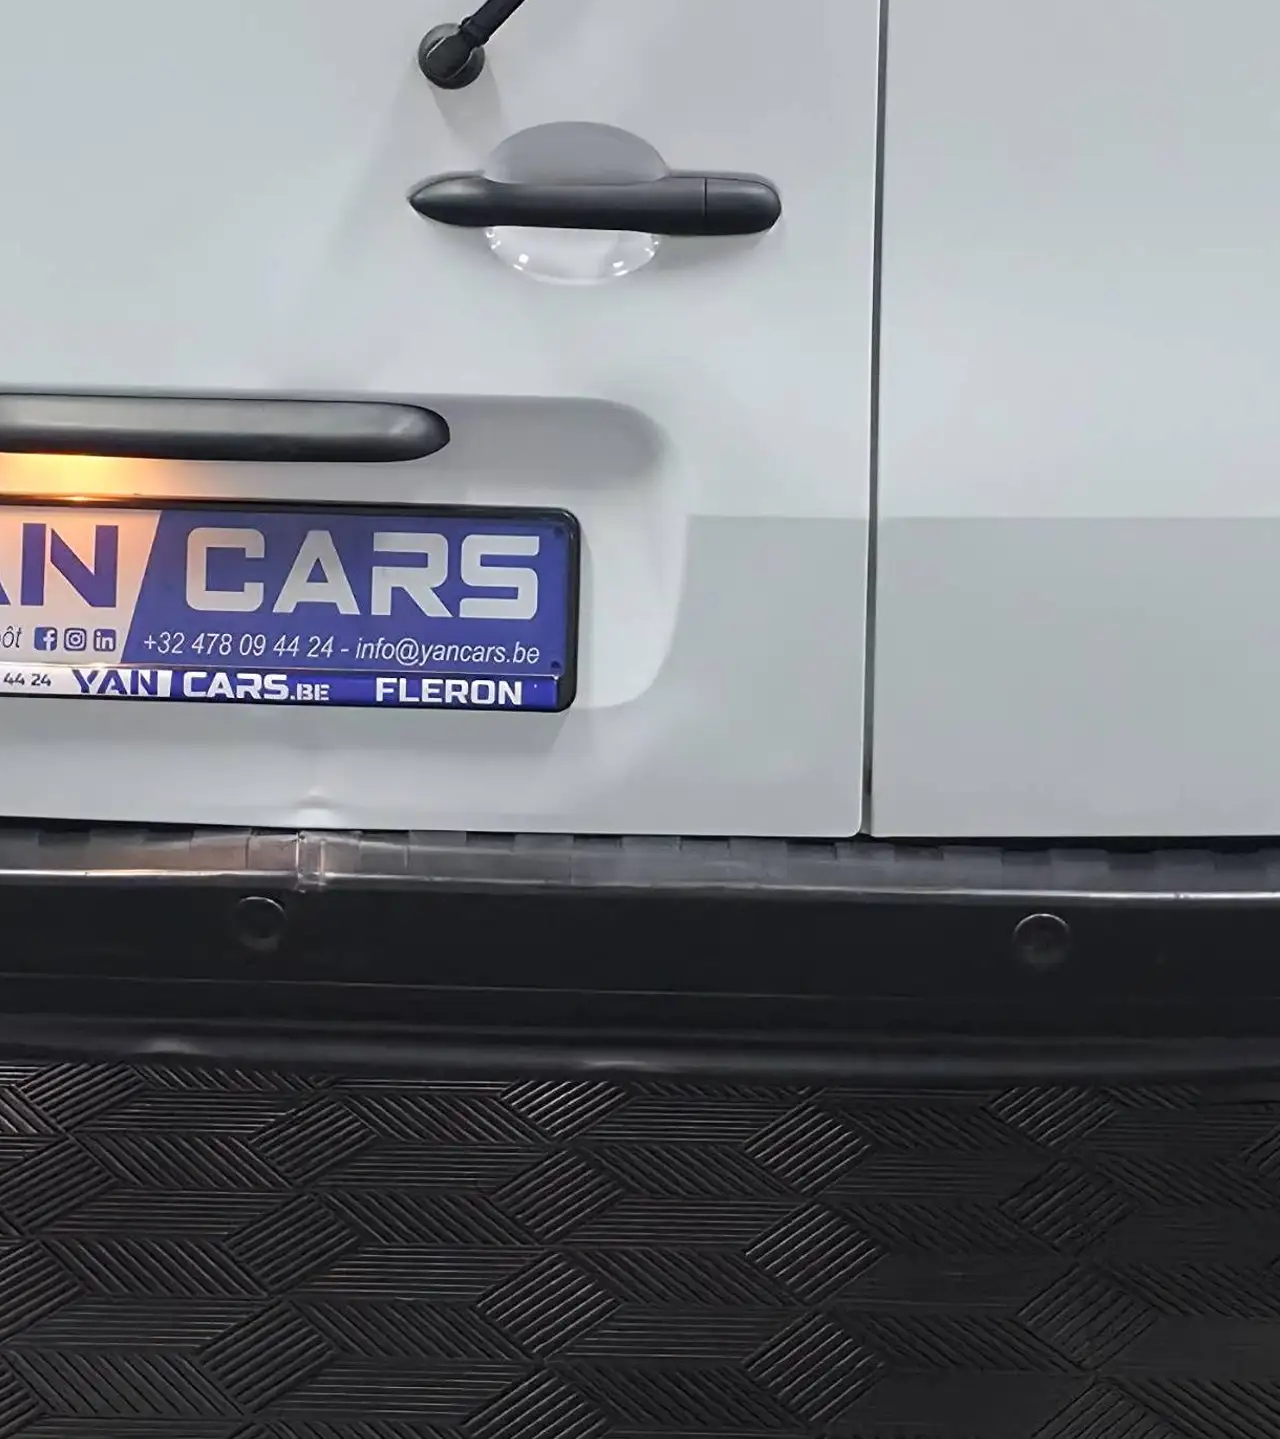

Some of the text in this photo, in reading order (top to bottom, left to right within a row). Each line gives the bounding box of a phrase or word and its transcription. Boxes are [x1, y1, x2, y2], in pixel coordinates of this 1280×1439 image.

[185, 526, 540, 621] CARS
[143, 631, 185, 655] +32
[191, 632, 233, 656] 478
[239, 633, 267, 657] 09
[273, 634, 300, 658] 44
[307, 635, 334, 659] 24
[355, 637, 540, 667] info@yancars.be
[3, 672, 25, 686] 44
[30, 673, 52, 687] 24
[72, 669, 159, 696] YAN
[375, 677, 523, 705] FLERON
